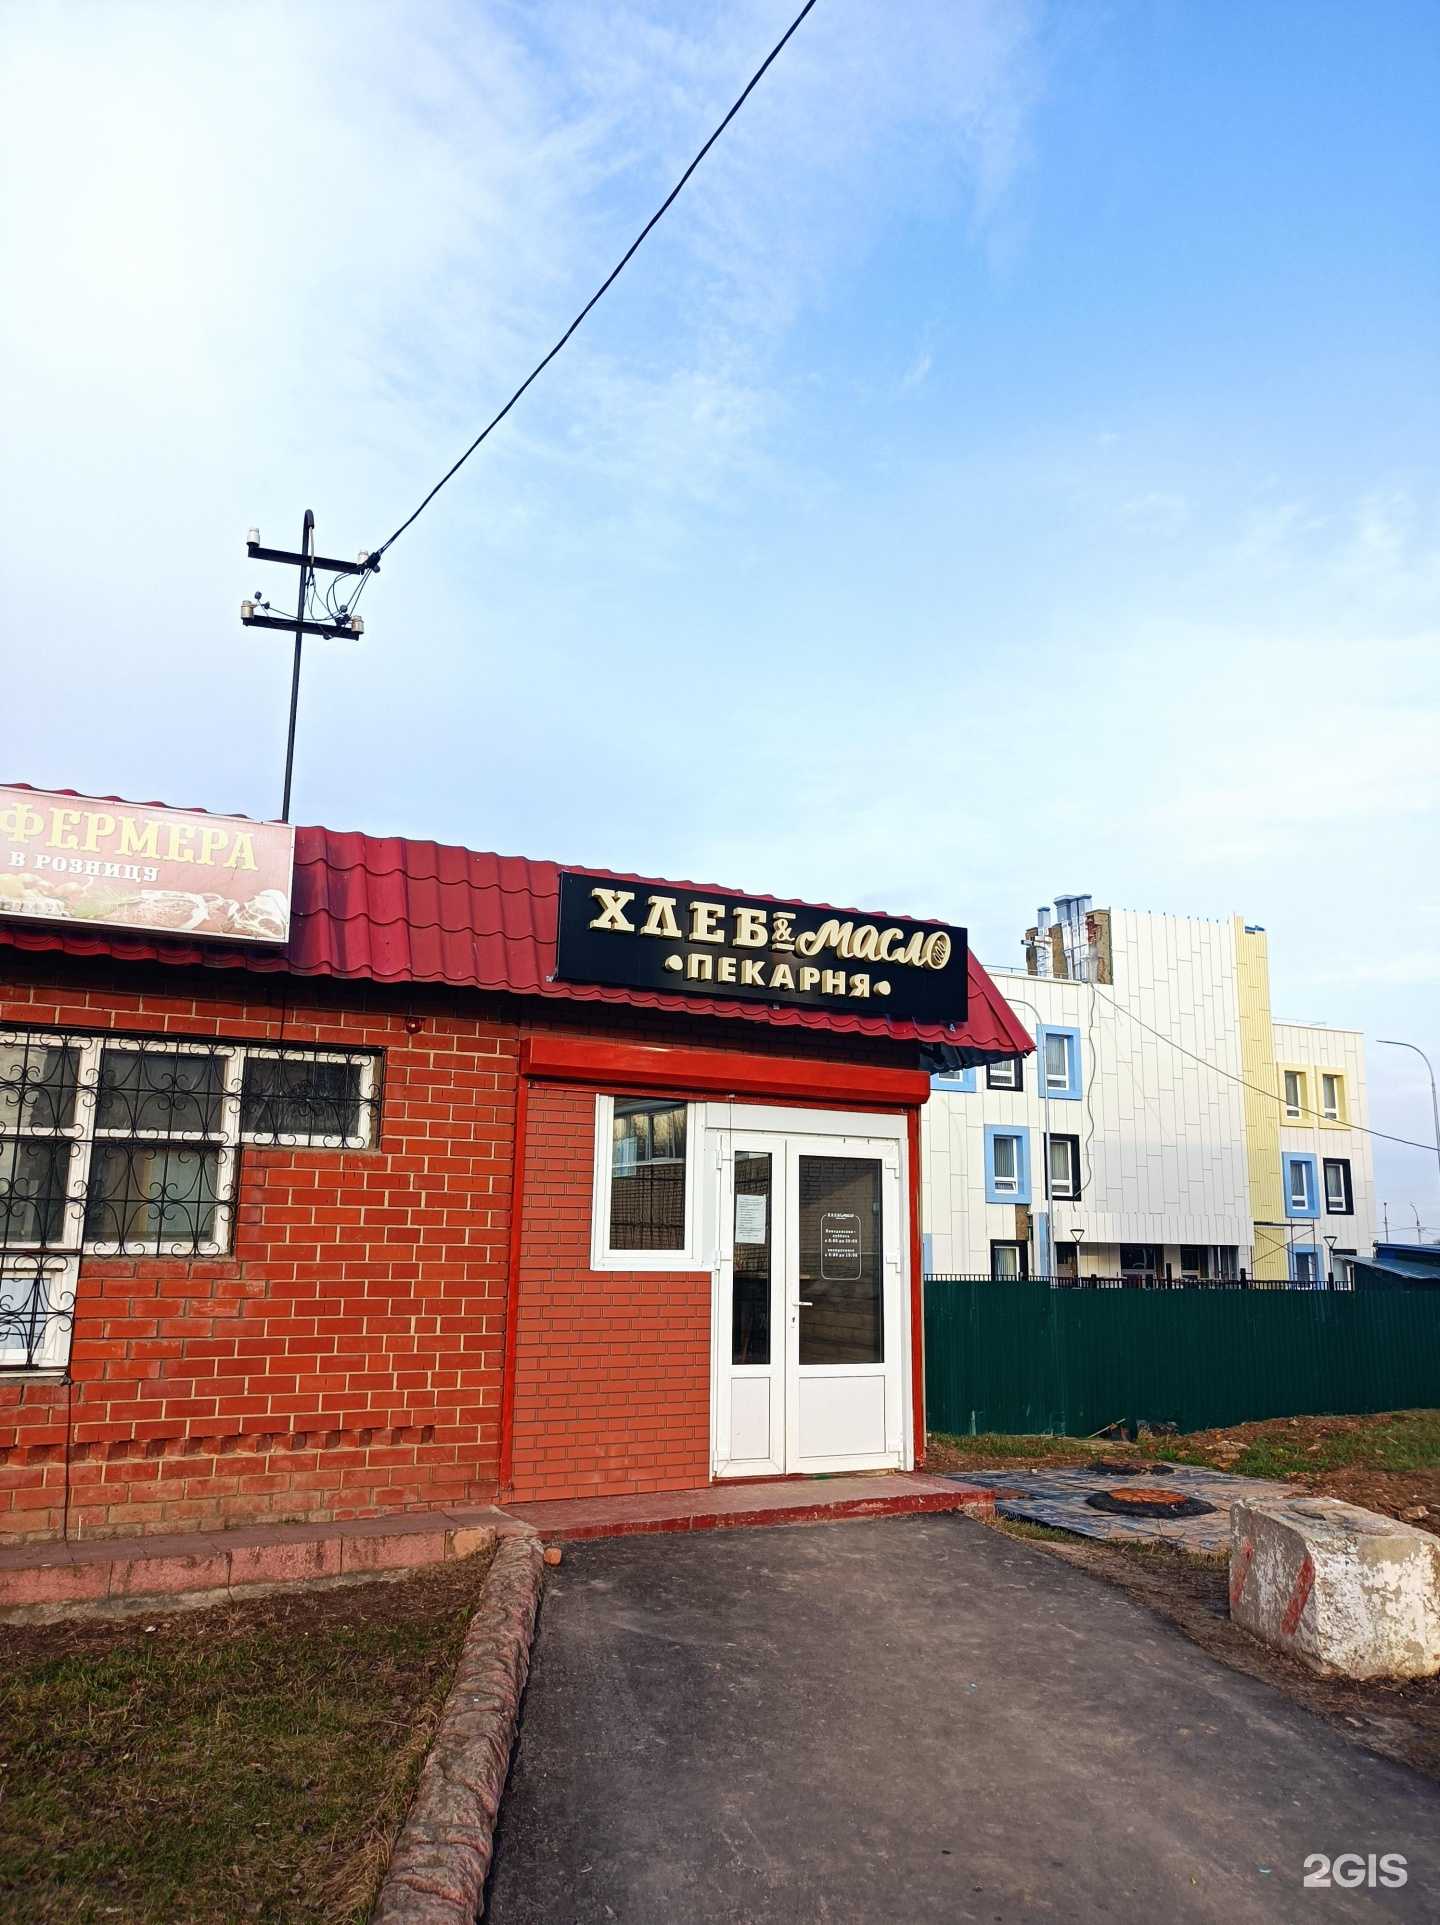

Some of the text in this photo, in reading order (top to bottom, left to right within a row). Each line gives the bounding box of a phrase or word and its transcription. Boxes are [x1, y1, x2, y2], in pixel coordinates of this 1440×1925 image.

[0, 803, 258, 871] ФЕРМЕРА
[8, 851, 25, 867] В
[589, 887, 767, 949] ХЛЕБ
[772, 912, 797, 951] &
